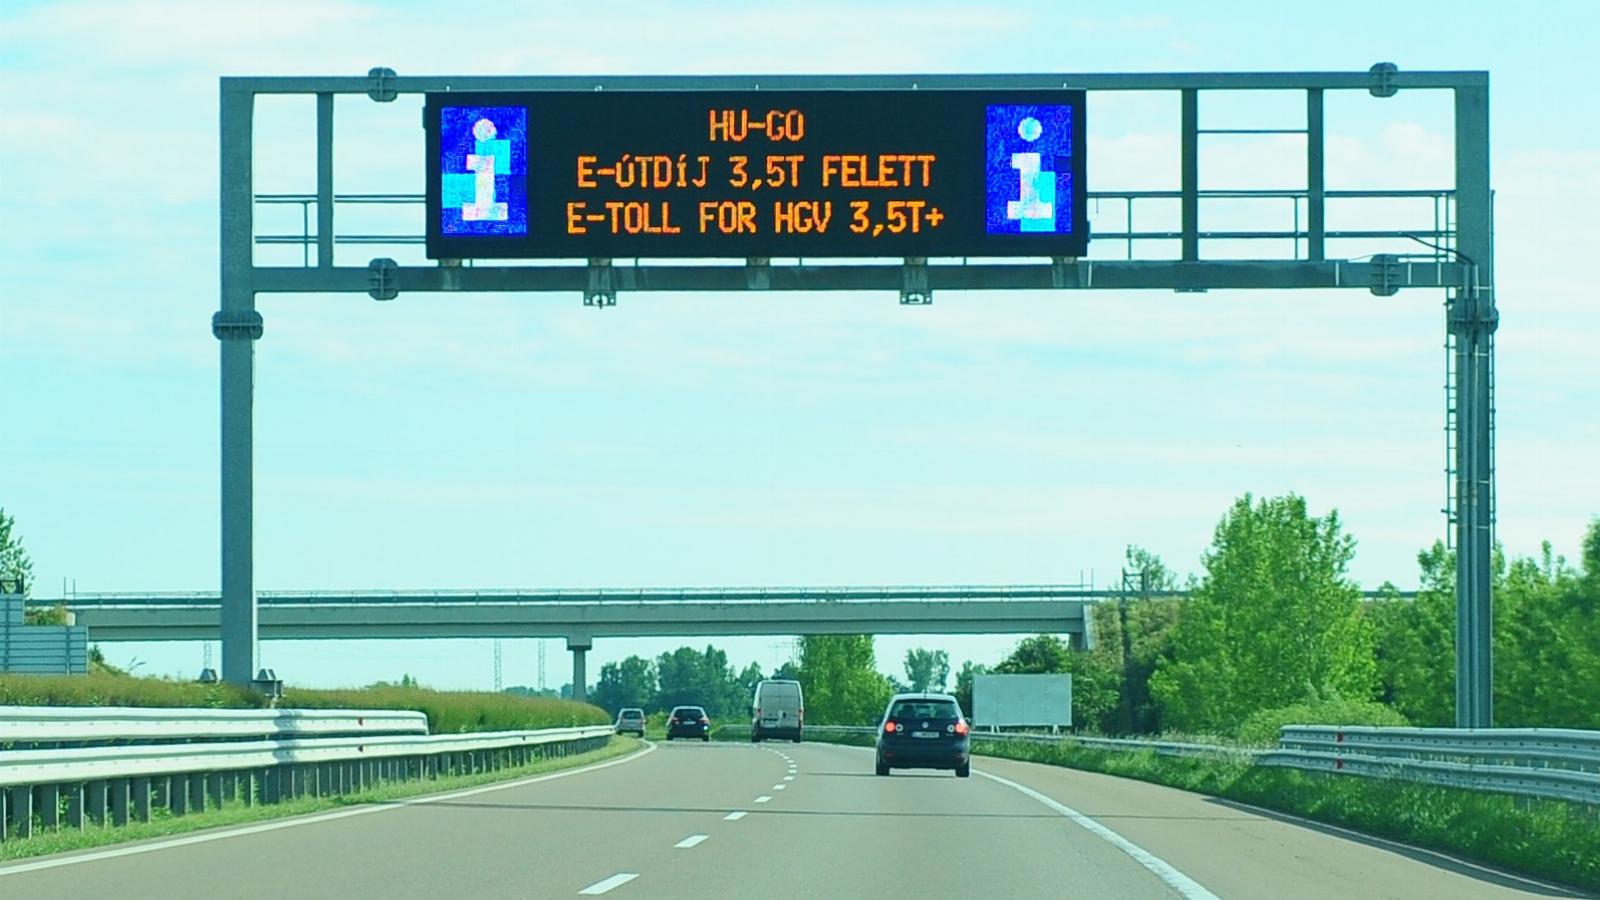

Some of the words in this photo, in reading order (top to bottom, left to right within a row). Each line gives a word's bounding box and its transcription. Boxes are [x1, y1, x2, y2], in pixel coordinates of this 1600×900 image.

[709, 109, 804, 141] HU-GO
[729, 154, 804, 190] 3,5T
[822, 154, 935, 187] FELETT
[567, 201, 680, 234] E-TOLL
[699, 200, 756, 233] FOR
[774, 200, 831, 232] HGV
[849, 200, 944, 236] 3,5T+
